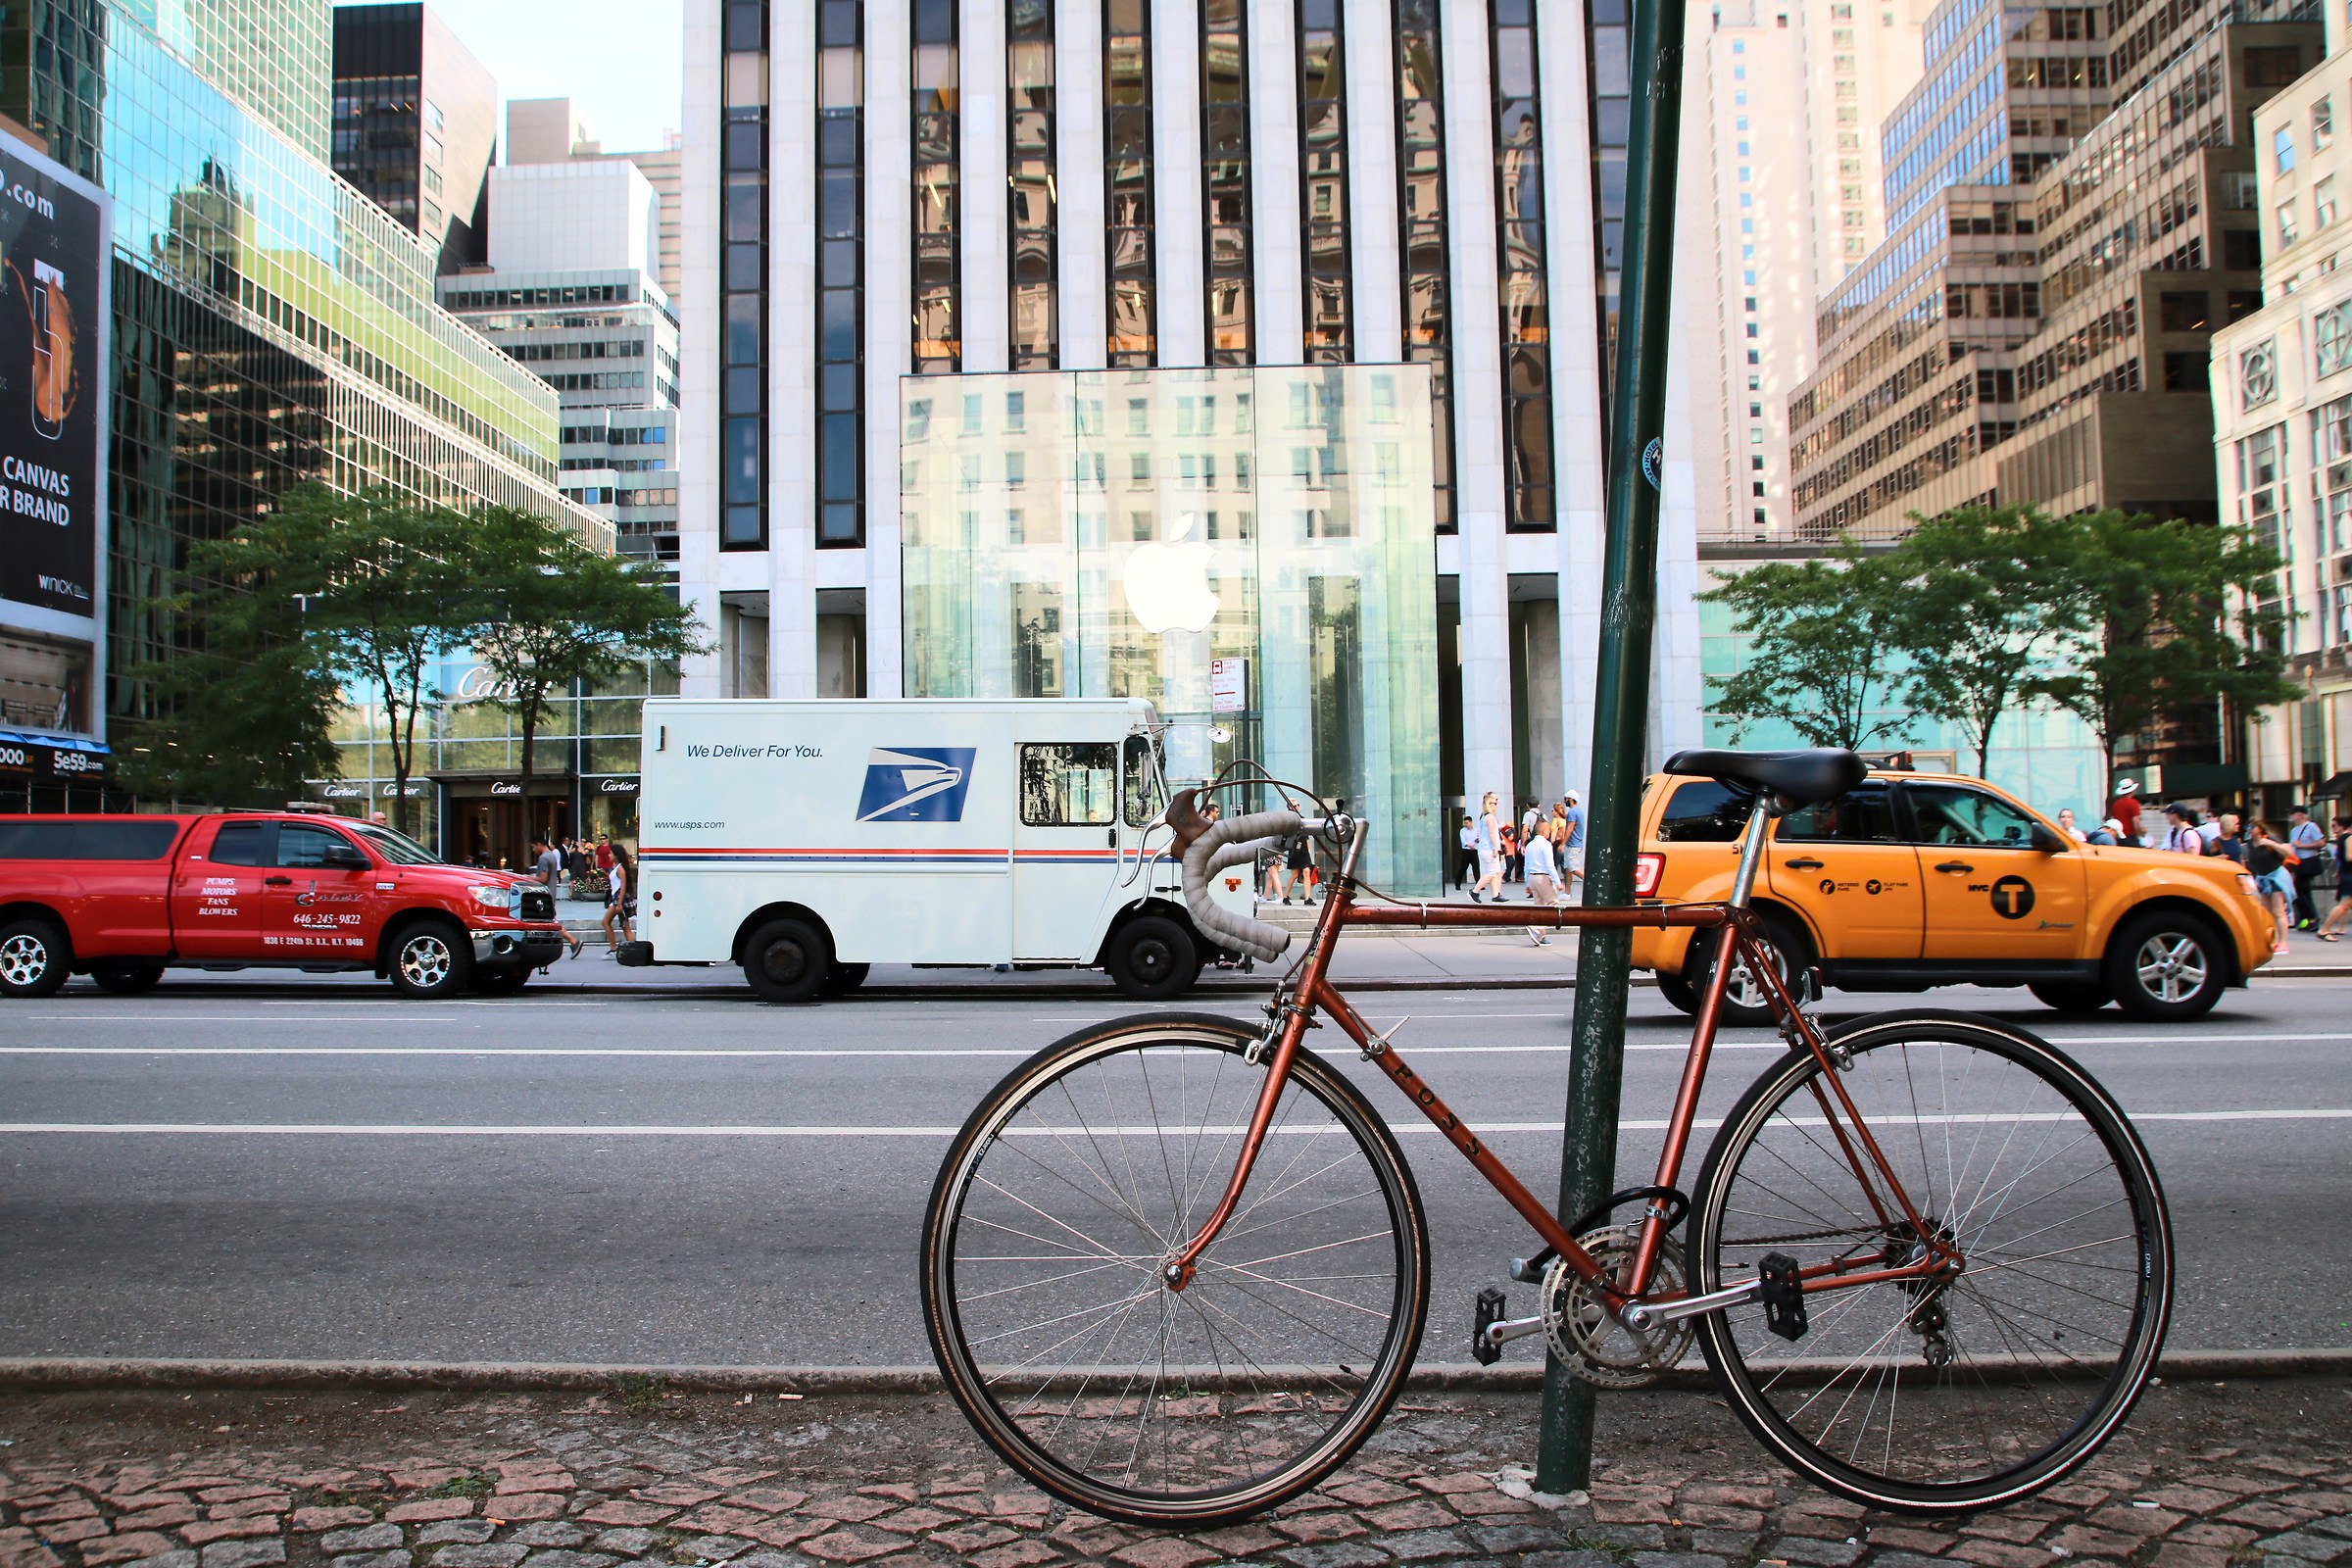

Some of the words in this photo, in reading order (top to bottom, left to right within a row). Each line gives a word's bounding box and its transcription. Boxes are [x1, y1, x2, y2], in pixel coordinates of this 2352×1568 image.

[3, 455, 70, 498] CANVAS
[13, 488, 70, 527] BRAND
[687, 745, 710, 758] We
[712, 745, 764, 758] Deliver
[766, 745, 792, 758] For
[794, 745, 823, 758] You.
[324, 785, 362, 797] Cartier
[601, 779, 639, 792] Cartier
[655, 821, 725, 831] www.usps.com
[201, 887, 238, 896] MOTORS
[208, 897, 230, 906] FANS
[1999, 884, 2026, 914] T
[198, 907, 239, 916] BLOWERS
[293, 913, 362, 925] 646-245-9822
[1395, 1062, 1481, 1156] ROSS
